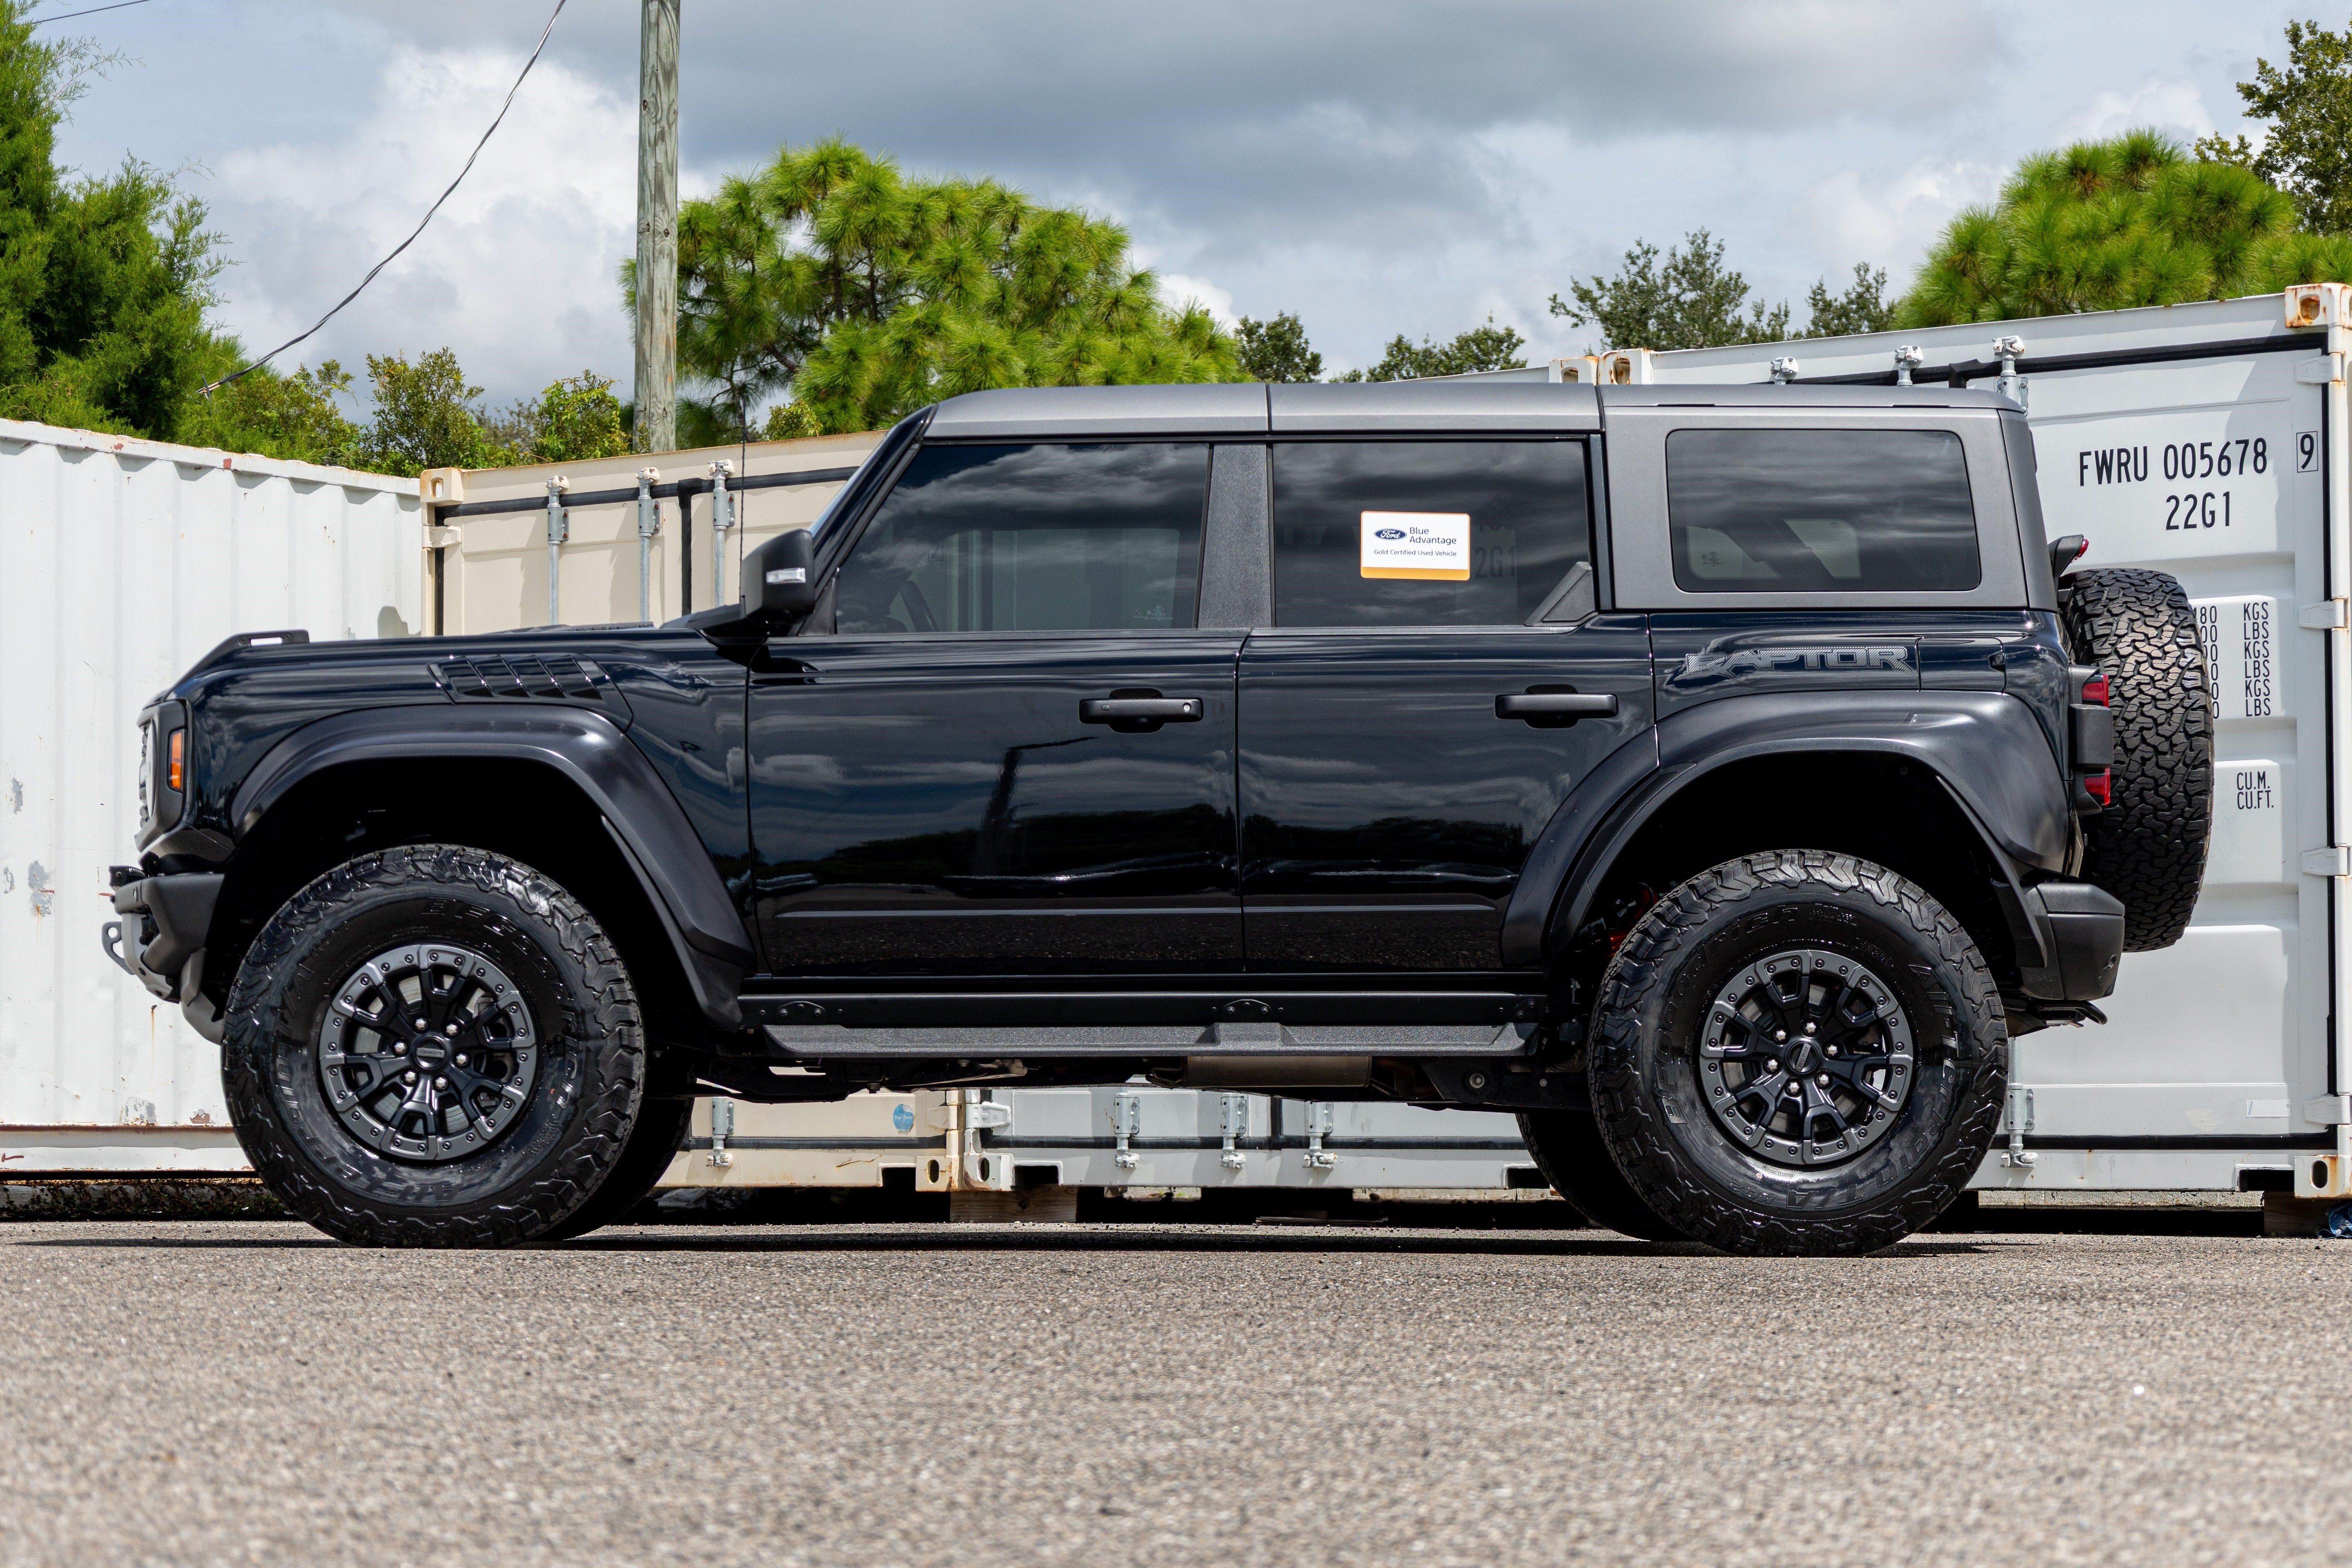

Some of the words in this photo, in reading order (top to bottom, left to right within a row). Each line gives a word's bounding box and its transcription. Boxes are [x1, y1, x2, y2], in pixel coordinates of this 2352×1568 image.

[2079, 445, 2148, 487] FWRU
[2164, 437, 2267, 480] 005678
[2300, 433, 2314, 470] 9
[2166, 491, 2230, 530] 22G1
[1380, 530, 1401, 539] Ford
[1409, 536, 1457, 546] Advantage
[2243, 601, 2269, 621] KGS
[2244, 621, 2269, 640] LBS
[2244, 640, 2270, 659] KGS
[1686, 646, 1918, 679] RAPTOR
[2245, 659, 2270, 679] LBS
[2245, 679, 2271, 698] KGS
[2246, 698, 2271, 717] LBS
[2237, 771, 2270, 790] CU.M.
[2237, 790, 2274, 810] CU.FT.
[1798, 1047, 1808, 1069] FORD
